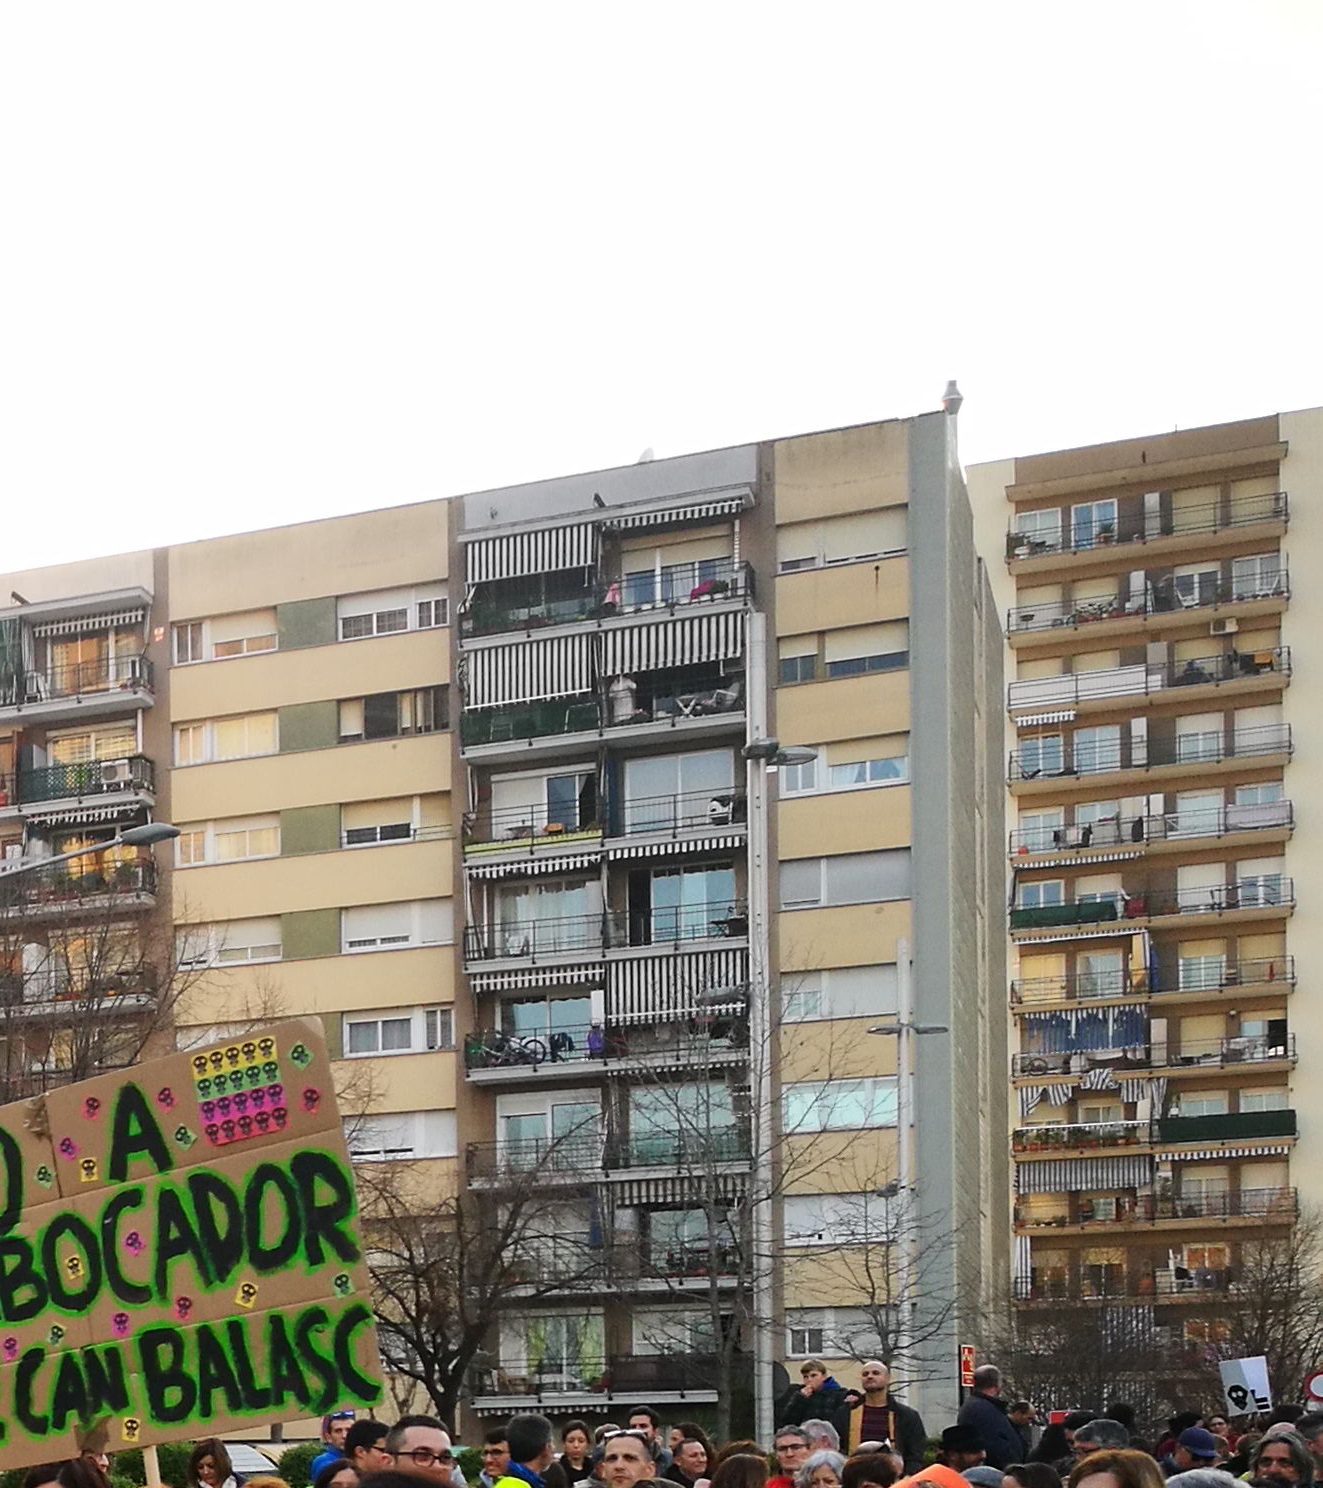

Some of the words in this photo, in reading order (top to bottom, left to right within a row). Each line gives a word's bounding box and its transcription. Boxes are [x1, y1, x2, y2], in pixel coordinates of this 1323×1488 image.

[108, 1081, 173, 1182] A
[12, 1342, 128, 1438] CAN
[137, 1302, 385, 1423] BALASC
